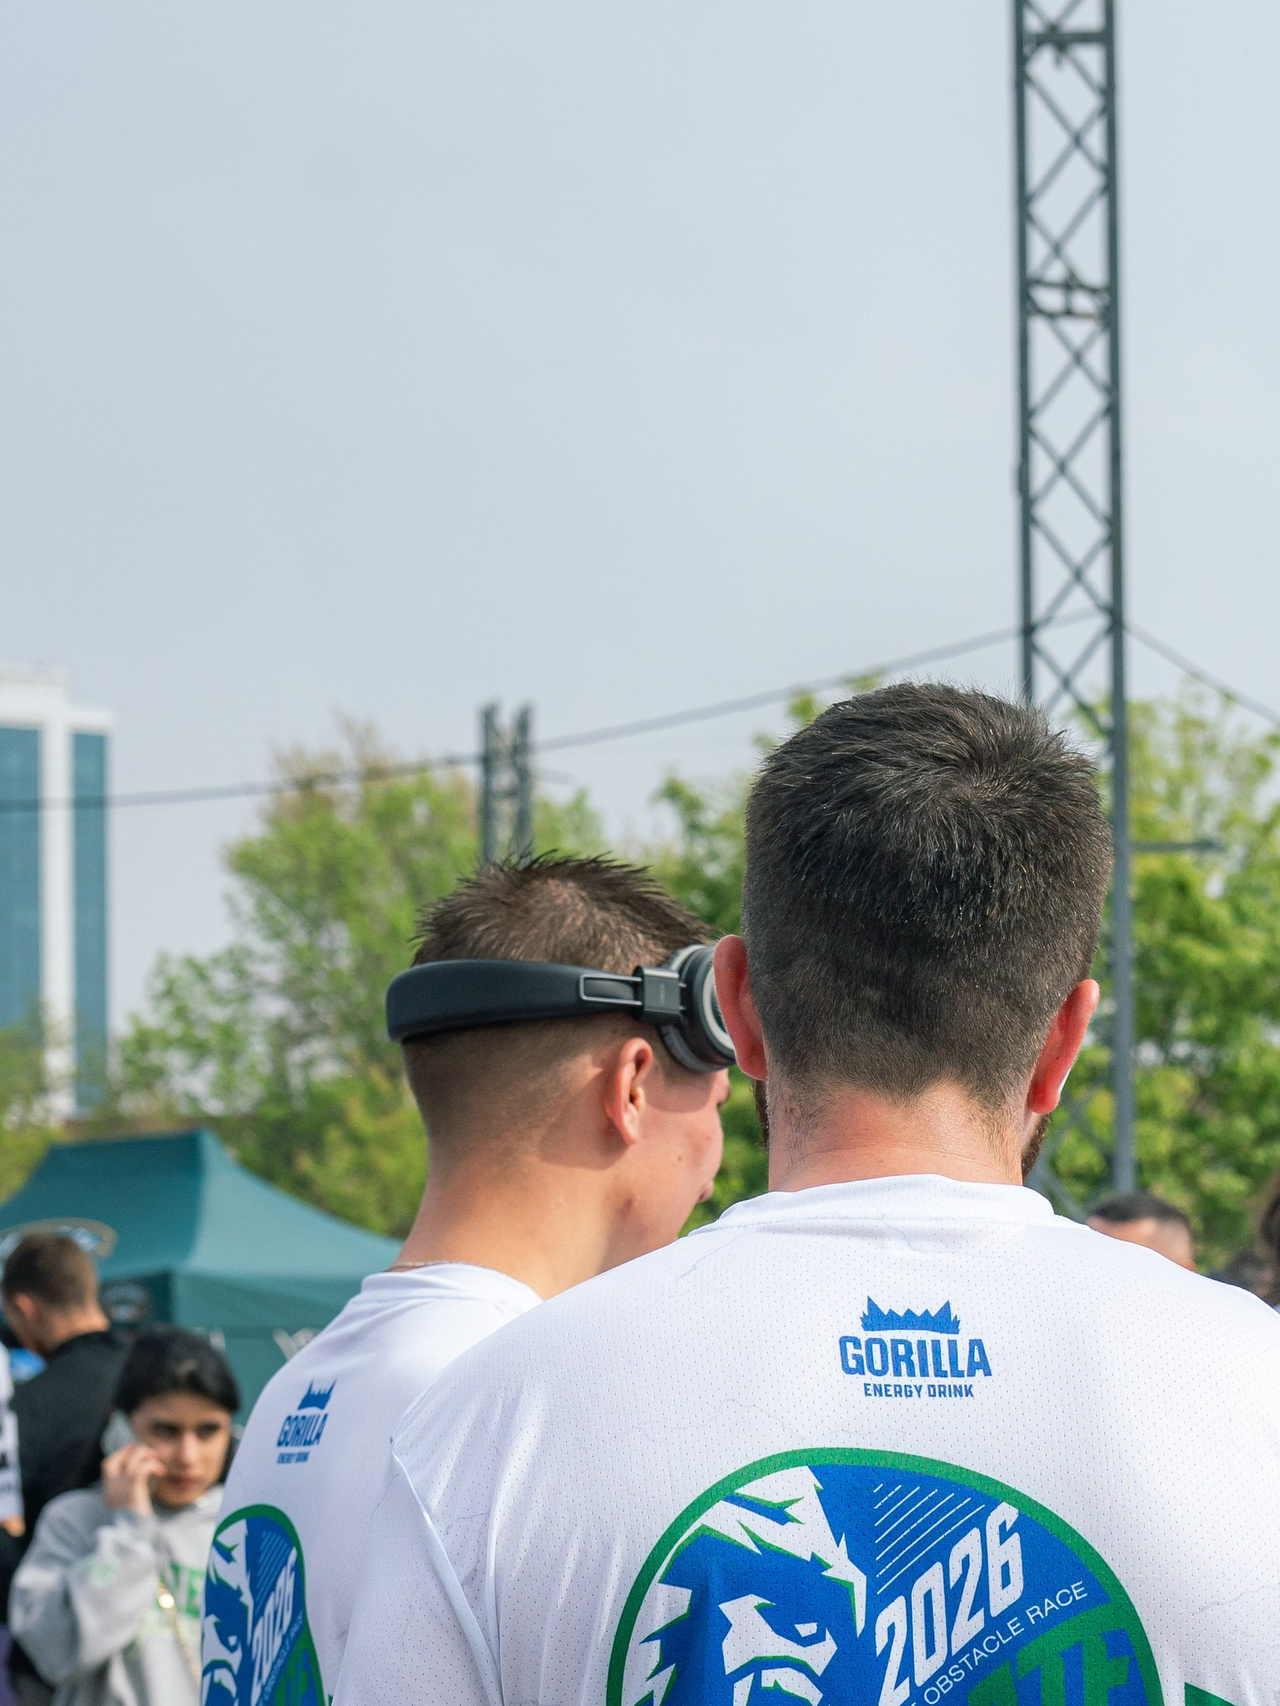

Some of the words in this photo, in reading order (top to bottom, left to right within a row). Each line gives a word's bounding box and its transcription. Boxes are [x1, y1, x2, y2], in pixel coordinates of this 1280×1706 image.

[838, 1335, 993, 1378] GORILLA
[863, 1382, 923, 1398] ENERGY
[927, 1384, 974, 1398] DRINK
[923, 1617, 1025, 1706] OBSTACLE
[1025, 1580, 1089, 1625] RACE
